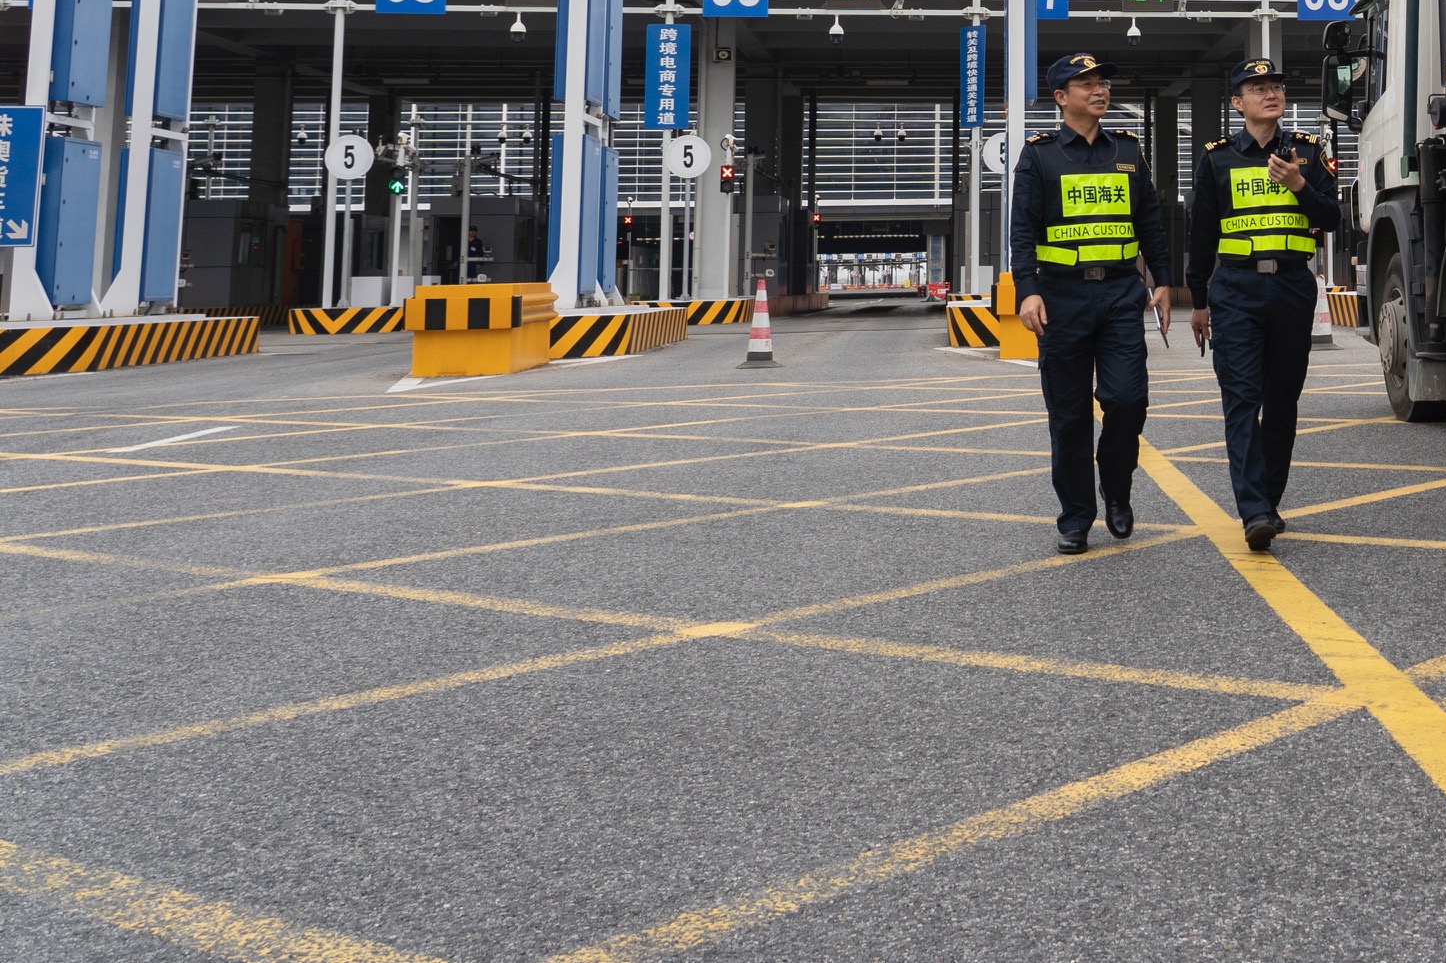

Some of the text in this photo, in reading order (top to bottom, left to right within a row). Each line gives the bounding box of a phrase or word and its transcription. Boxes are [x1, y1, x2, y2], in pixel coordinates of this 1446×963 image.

[657, 27, 678, 126] 跨境电商专用道
[344, 145, 355, 169] 5
[683, 145, 694, 168] 5
[1067, 185, 1126, 205] 中国海关
[1054, 223, 1134, 239] CHINA CUSTOM
[1225, 215, 1305, 231] CHINA CUSTOMS
